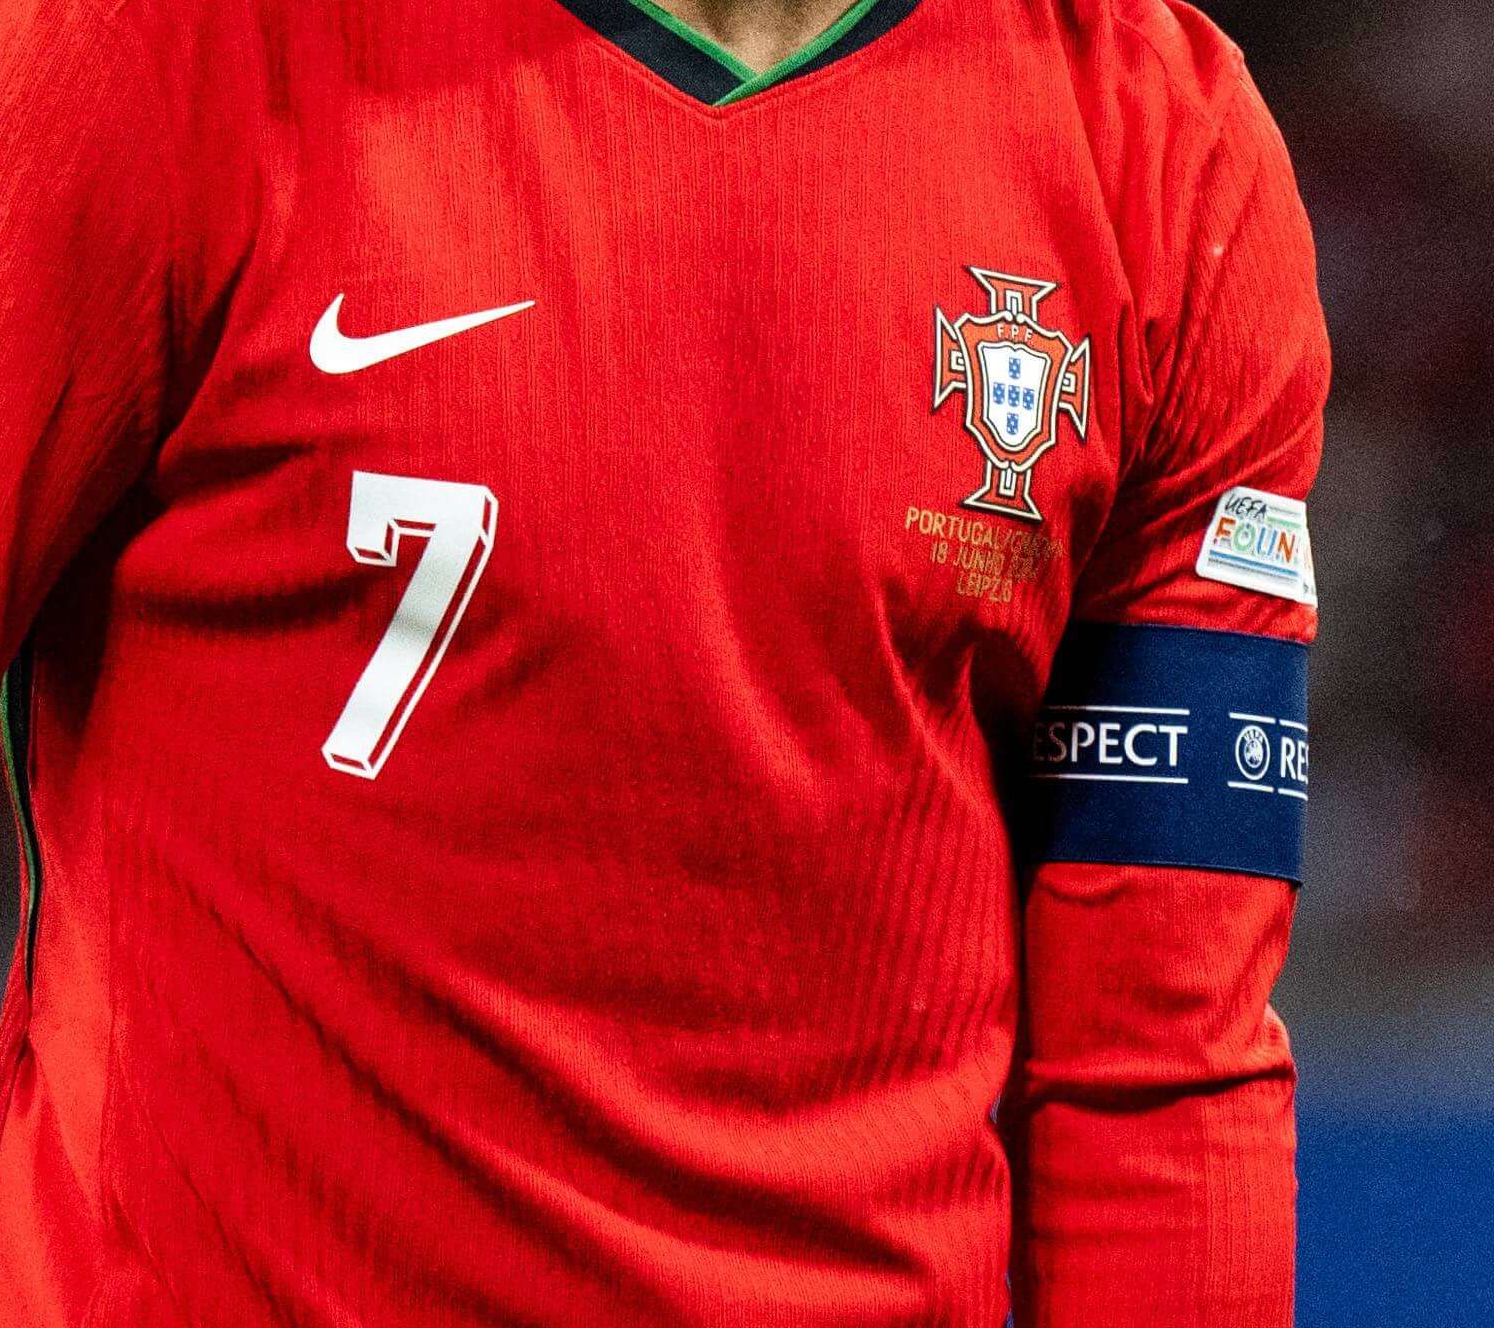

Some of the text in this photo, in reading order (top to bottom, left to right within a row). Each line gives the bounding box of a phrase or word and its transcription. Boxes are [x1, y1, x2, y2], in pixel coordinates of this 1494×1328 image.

[996, 322, 1033, 342] FPF
[1224, 493, 1267, 519] UEFA
[931, 540, 949, 565] 18
[321, 469, 499, 780] 7
[1280, 736, 1309, 785] RE
